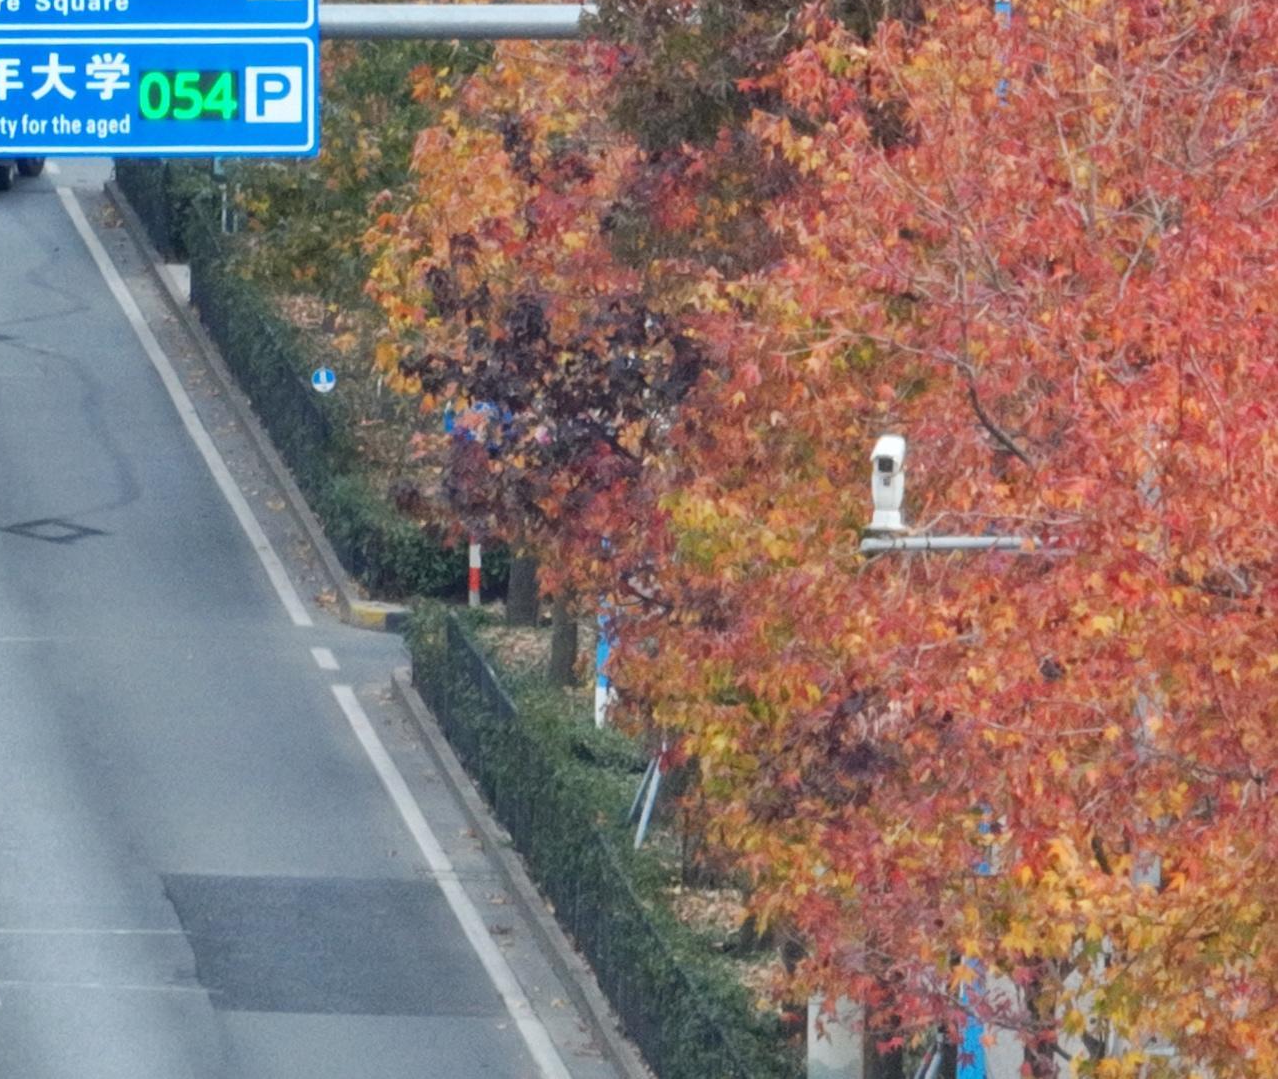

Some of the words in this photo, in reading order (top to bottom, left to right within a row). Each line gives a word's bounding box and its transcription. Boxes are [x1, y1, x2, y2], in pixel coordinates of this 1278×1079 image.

[139, 70, 239, 120] 054
[255, 73, 291, 116] P
[21, 114, 48, 134] for
[52, 115, 82, 134] the
[86, 114, 131, 139] aged
